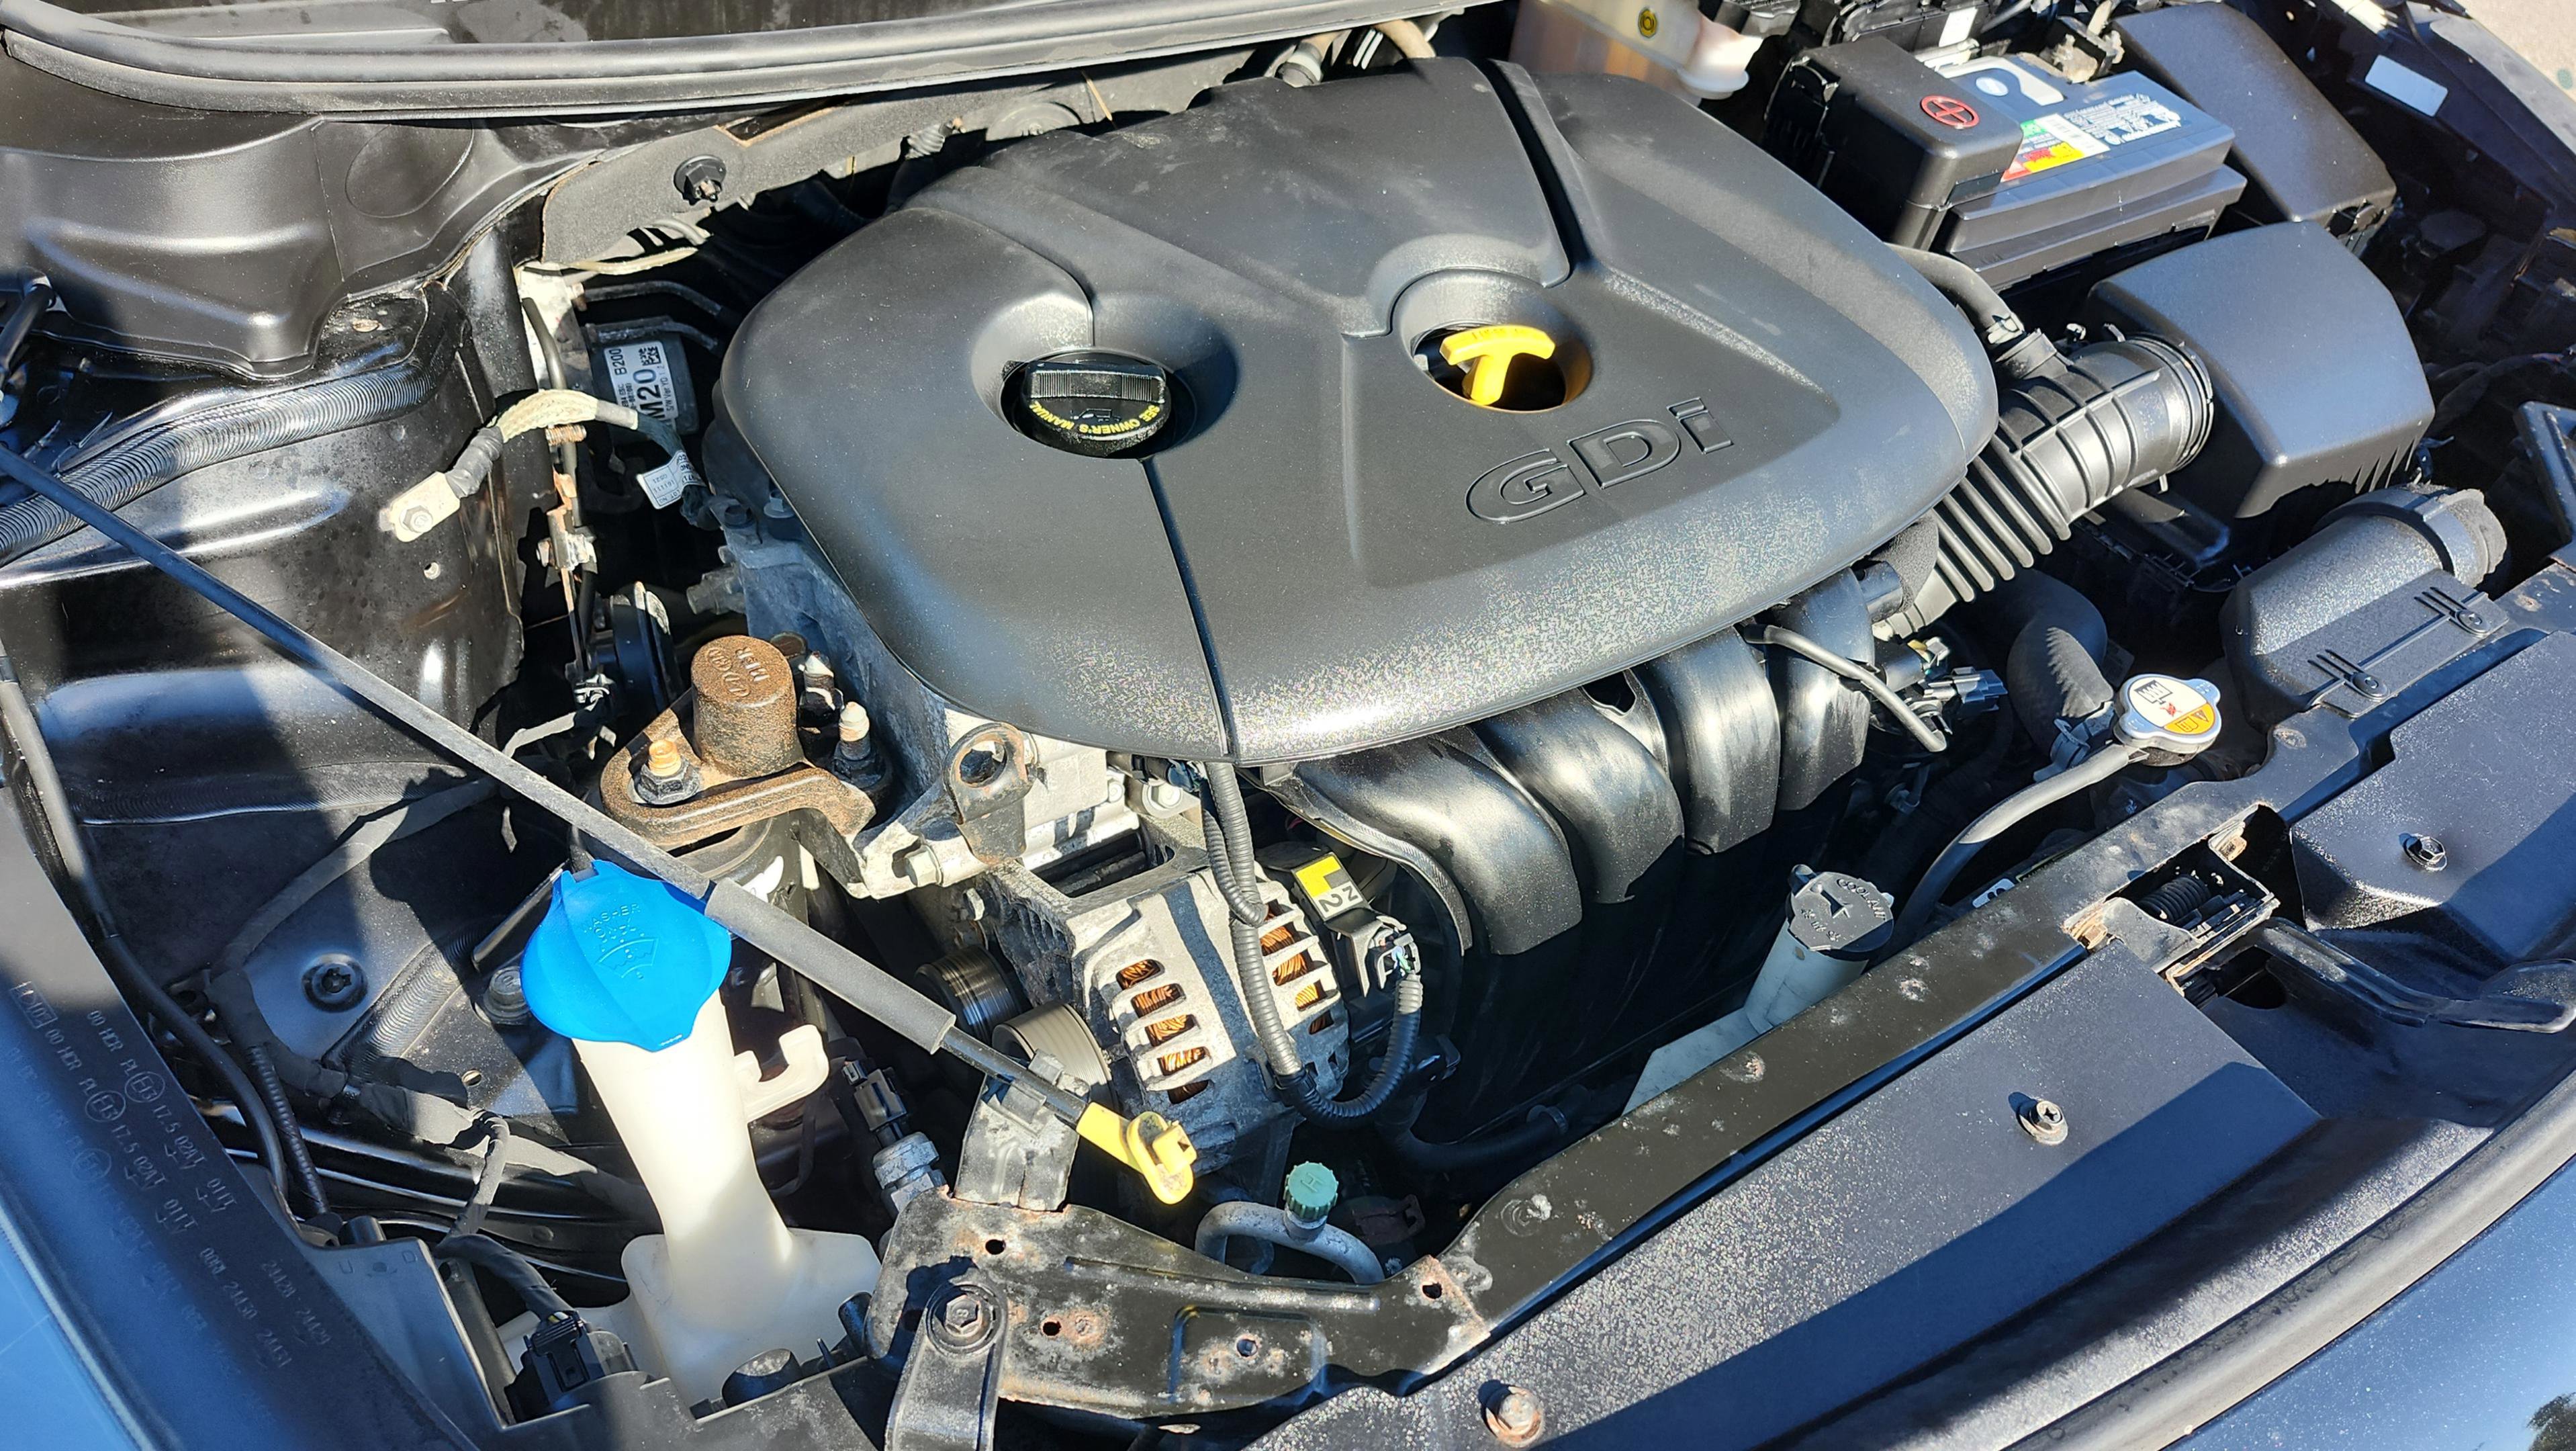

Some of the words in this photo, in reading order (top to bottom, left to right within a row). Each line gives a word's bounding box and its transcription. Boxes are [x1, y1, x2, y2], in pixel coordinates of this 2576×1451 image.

[608, 348, 627, 376] B200
[1029, 401, 1074, 430] MANUAL
[1139, 404, 1160, 422] SEE
[1078, 419, 1140, 435] OWNER'S
[118, 1057, 140, 1074] PL
[77, 1077, 101, 1095] PL
